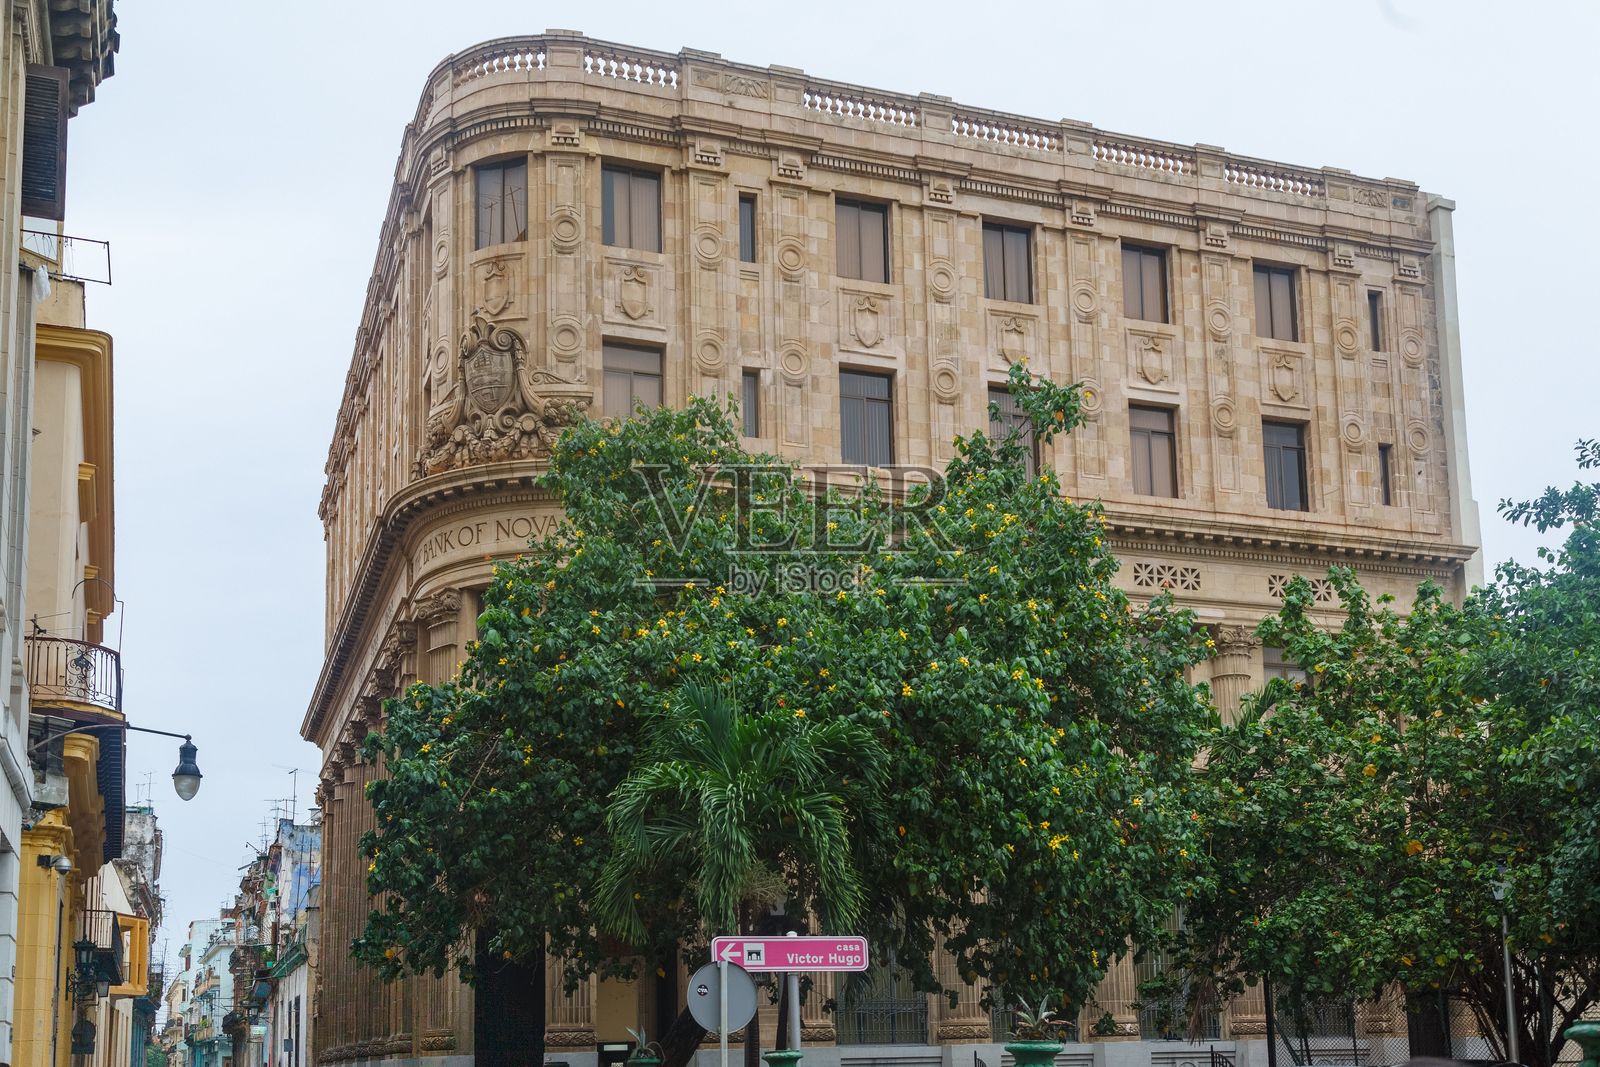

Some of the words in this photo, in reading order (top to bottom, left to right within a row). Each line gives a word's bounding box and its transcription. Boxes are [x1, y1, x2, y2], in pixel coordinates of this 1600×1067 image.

[423, 530, 455, 565] BANK
[458, 521, 488, 547] OF
[496, 514, 559, 543] NOVA
[836, 944, 860, 952] casa
[787, 953, 824, 964] Victor
[829, 953, 861, 966] Hugo
